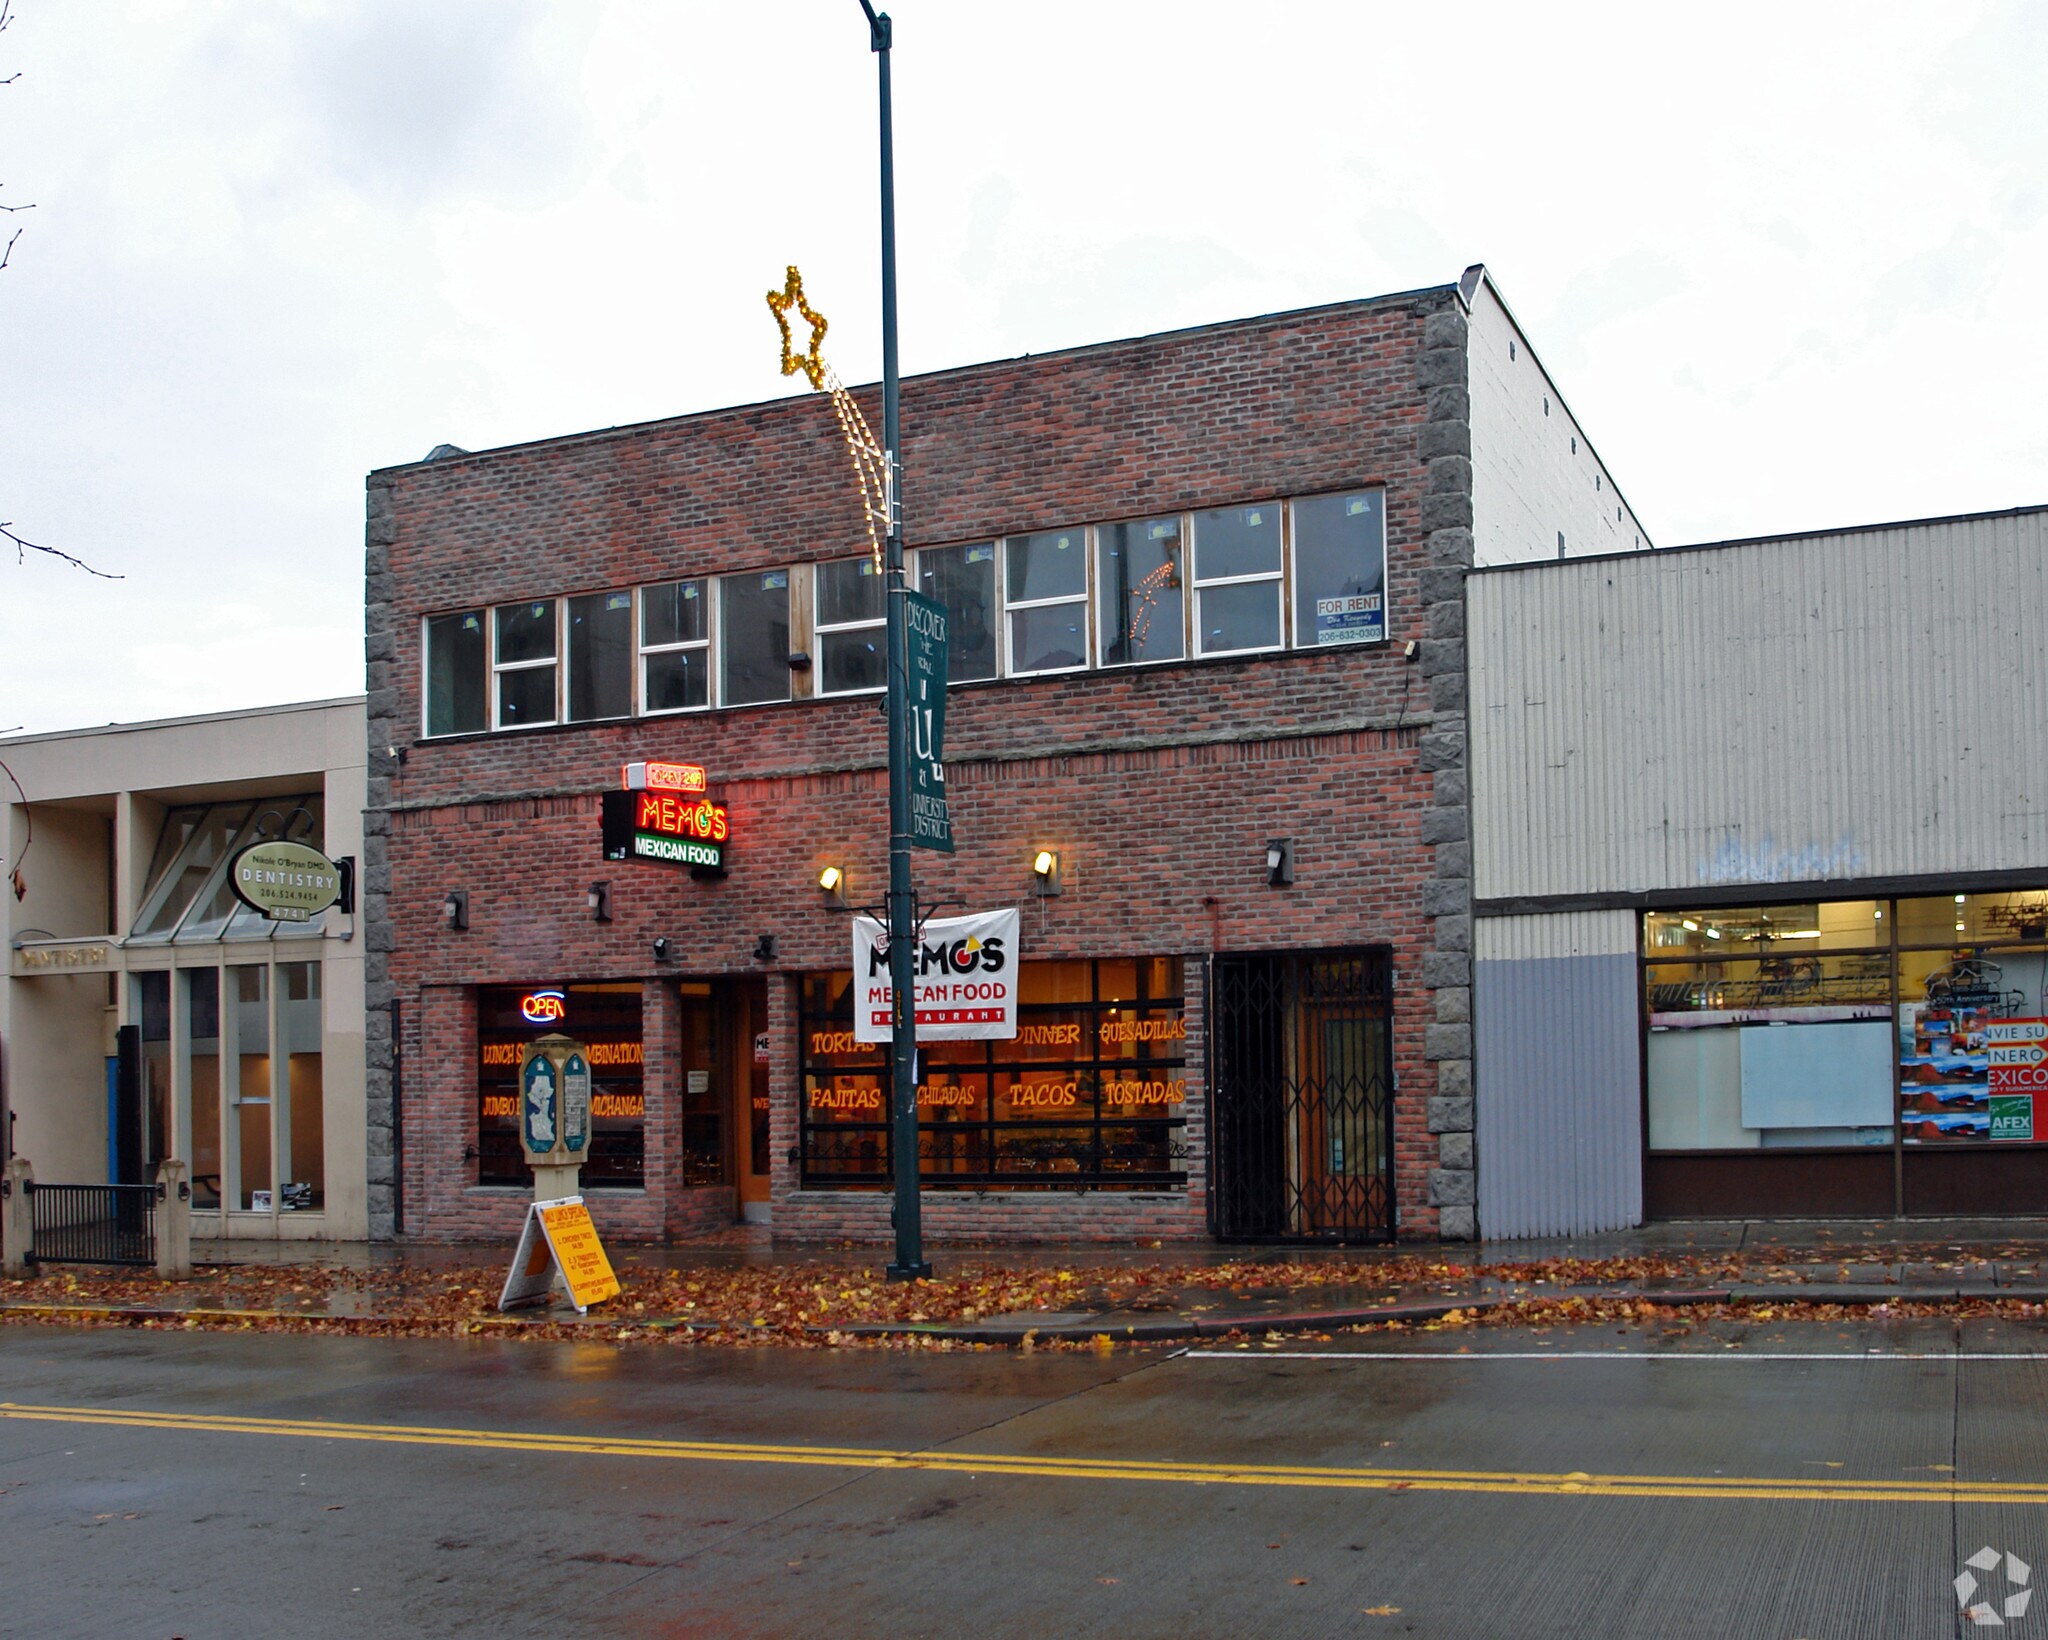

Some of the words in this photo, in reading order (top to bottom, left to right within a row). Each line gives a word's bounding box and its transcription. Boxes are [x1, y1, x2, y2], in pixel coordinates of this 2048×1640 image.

[1319, 600, 1342, 614] FOR
[1348, 596, 1378, 611] RENT
[908, 600, 946, 642] DISCOVER
[655, 769, 680, 784] OPEN
[912, 793, 950, 820] UNIVERSITY
[915, 814, 950, 840] DISTRICT
[635, 837, 687, 861] MEXICAN
[688, 847, 719, 866] FOOD
[307, 861, 326, 871] DMD
[242, 868, 334, 889] DENTISTRY
[273, 908, 306, 919] 4741
[868, 985, 948, 1004] MECAN
[952, 983, 1006, 1001] FOOD
[522, 996, 566, 1018] OPEN
[874, 1010, 1002, 1023] REAURANT
[1009, 1024, 1080, 1045] DINNER
[1101, 1017, 1186, 1044] QUESADILLAS
[2026, 1026, 2044, 1038] SU
[483, 1043, 515, 1065] LUNCH
[585, 1042, 643, 1065] MBINATION
[1988, 1049, 2043, 1062] INERO
[1988, 1068, 2048, 1086] EXICO
[810, 1087, 881, 1109] FAJITAS
[916, 1085, 975, 1105] CHILADAS
[1010, 1082, 1077, 1106] TACOS
[1106, 1079, 1185, 1105] TOSTADAS
[483, 1096, 515, 1116] JUMBO
[590, 1094, 644, 1117] MICHANGA
[1992, 1116, 2030, 1129] AFEX
